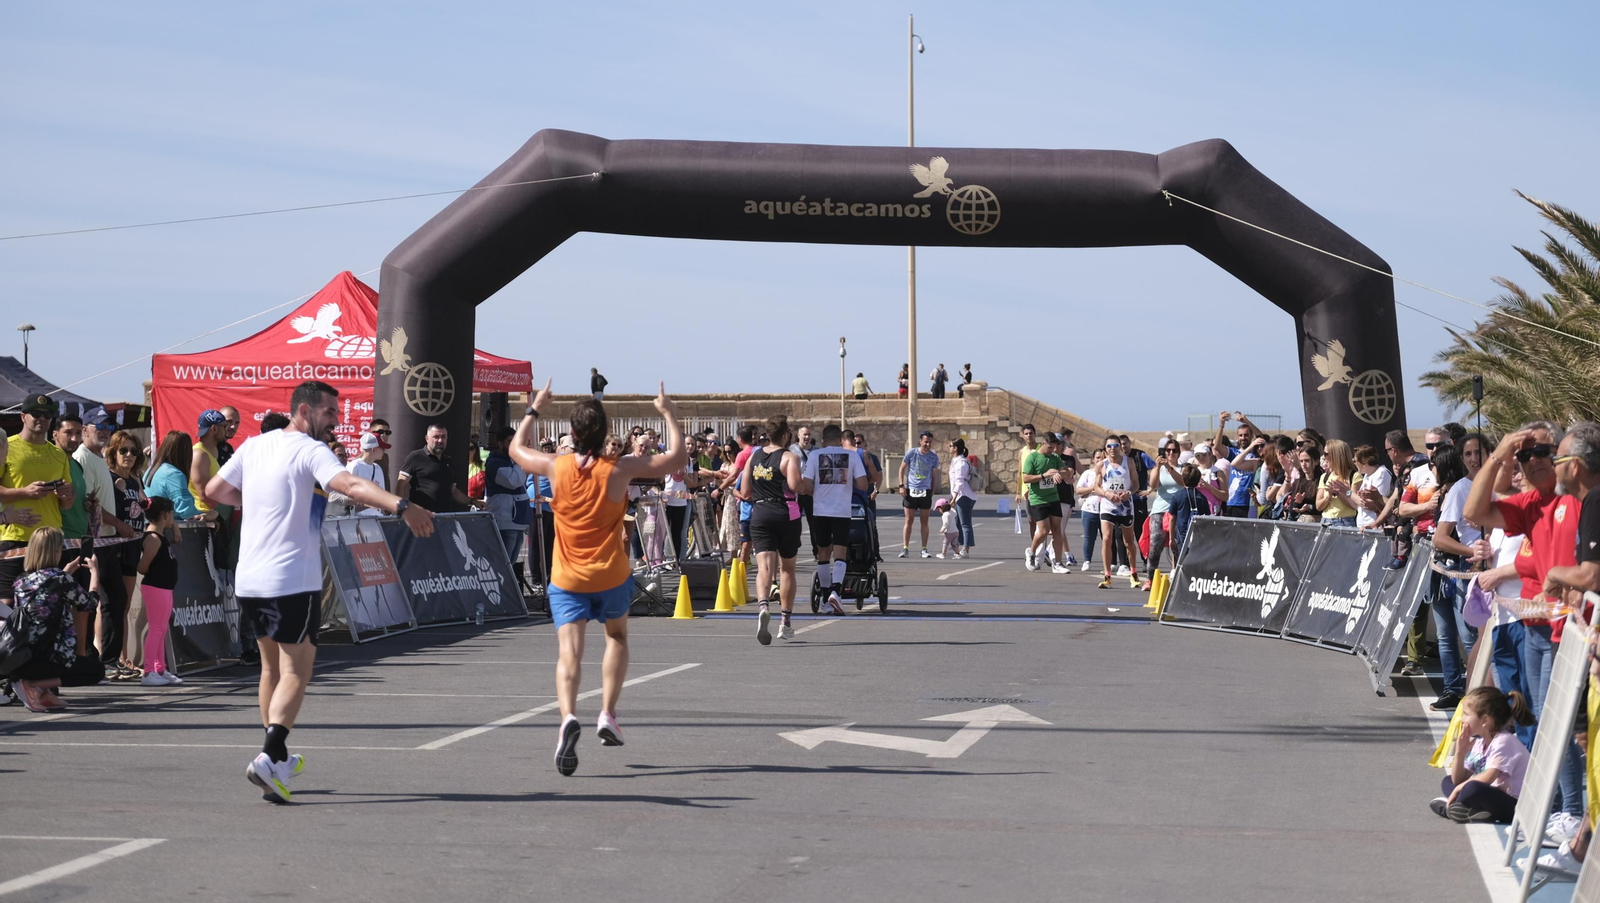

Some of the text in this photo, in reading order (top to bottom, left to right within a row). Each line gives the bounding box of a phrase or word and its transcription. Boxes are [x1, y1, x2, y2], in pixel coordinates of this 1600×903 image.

[743, 195, 931, 219] aquéatacamos
[172, 361, 375, 384] www.aqueatacamo
[1109, 483, 1125, 491] 474
[410, 571, 481, 601] aquéatacamos
[1188, 572, 1266, 601] aquéatacamos
